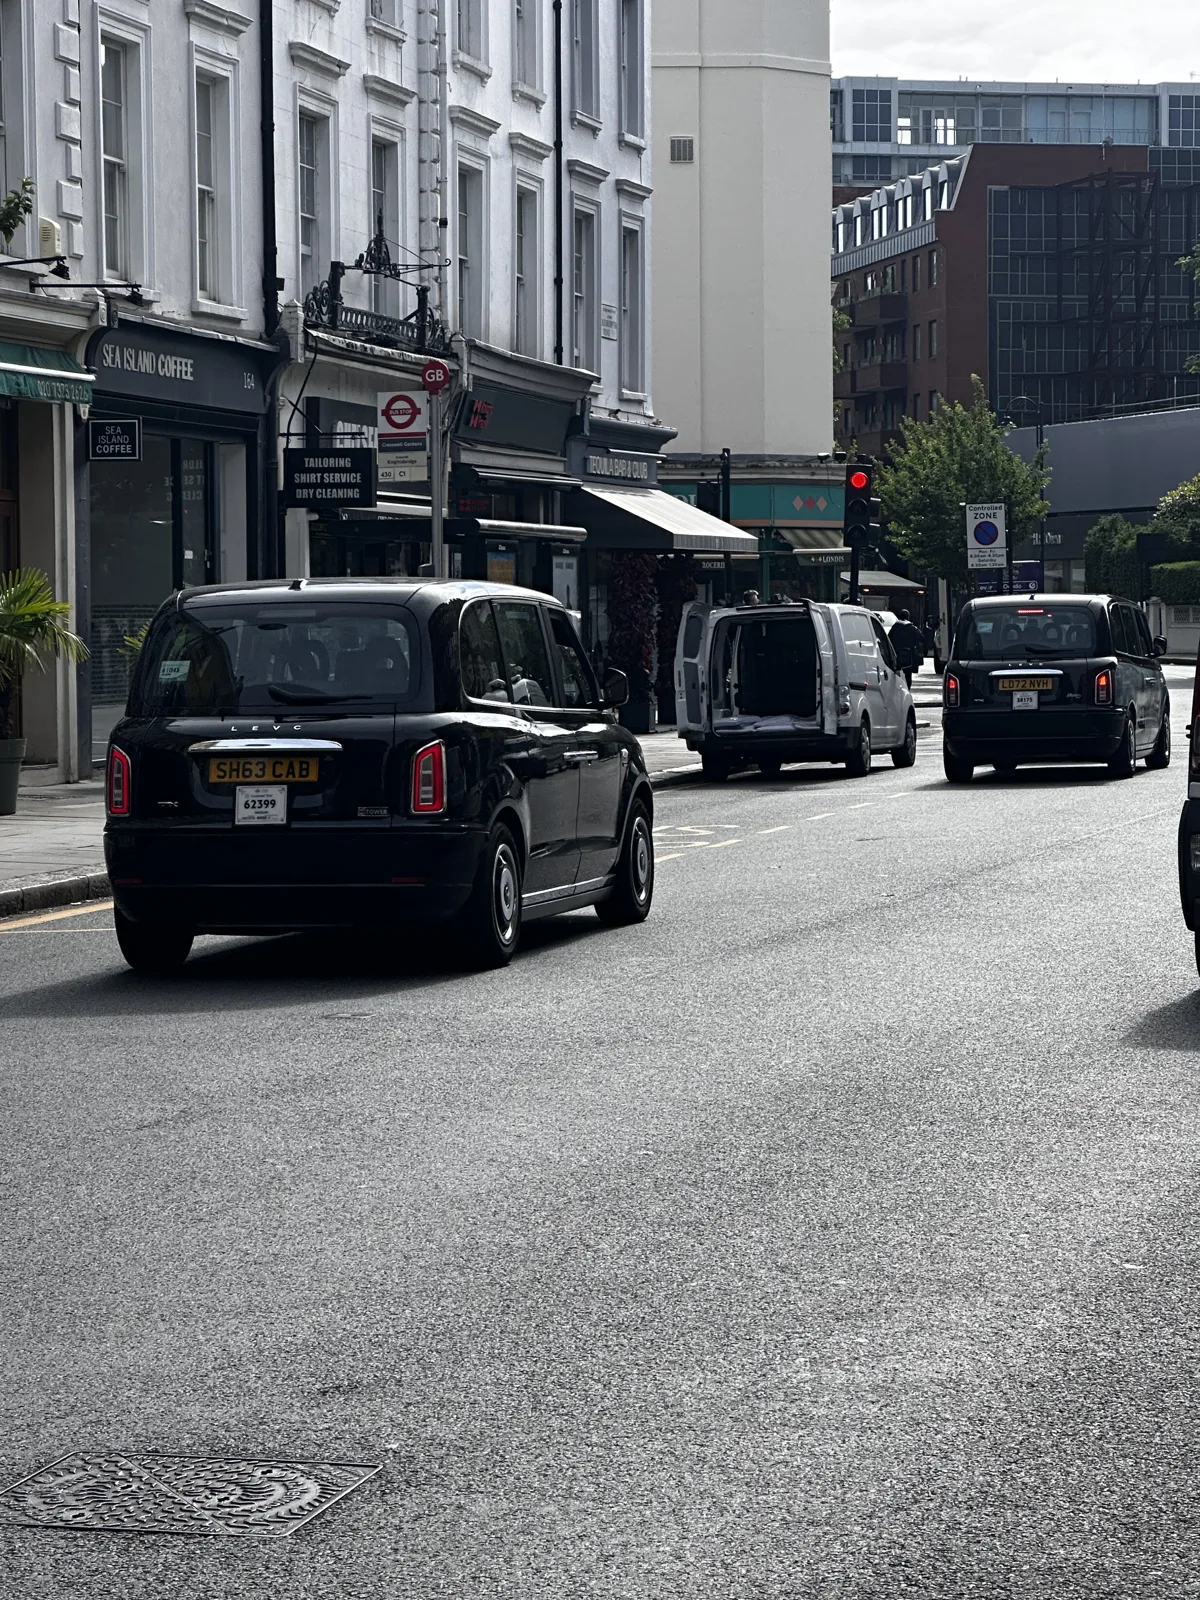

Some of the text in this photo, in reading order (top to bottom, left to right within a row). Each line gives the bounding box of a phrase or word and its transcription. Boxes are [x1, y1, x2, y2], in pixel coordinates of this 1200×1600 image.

[102, 343, 194, 380] SEA ISLAND COFFEE
[425, 369, 444, 382] GB
[105, 425, 121, 435] SEA
[98, 435, 130, 444] ISLAND
[96, 444, 132, 453] COFFEE
[304, 457, 352, 468] TAILORING
[588, 455, 614, 476] TEQUILA
[614, 459, 627, 477] BAR
[632, 460, 648, 479] CLUB
[294, 472, 362, 483] SHIRT SERVICE
[295, 488, 360, 499] DRY CLEANING
[973, 512, 998, 520] ZONE
[822, 555, 845, 563] LONDIS
[1002, 679, 1049, 689] LD72 NVH
[216, 760, 310, 779] SH63 CAB
[243, 799, 276, 809] 62399
